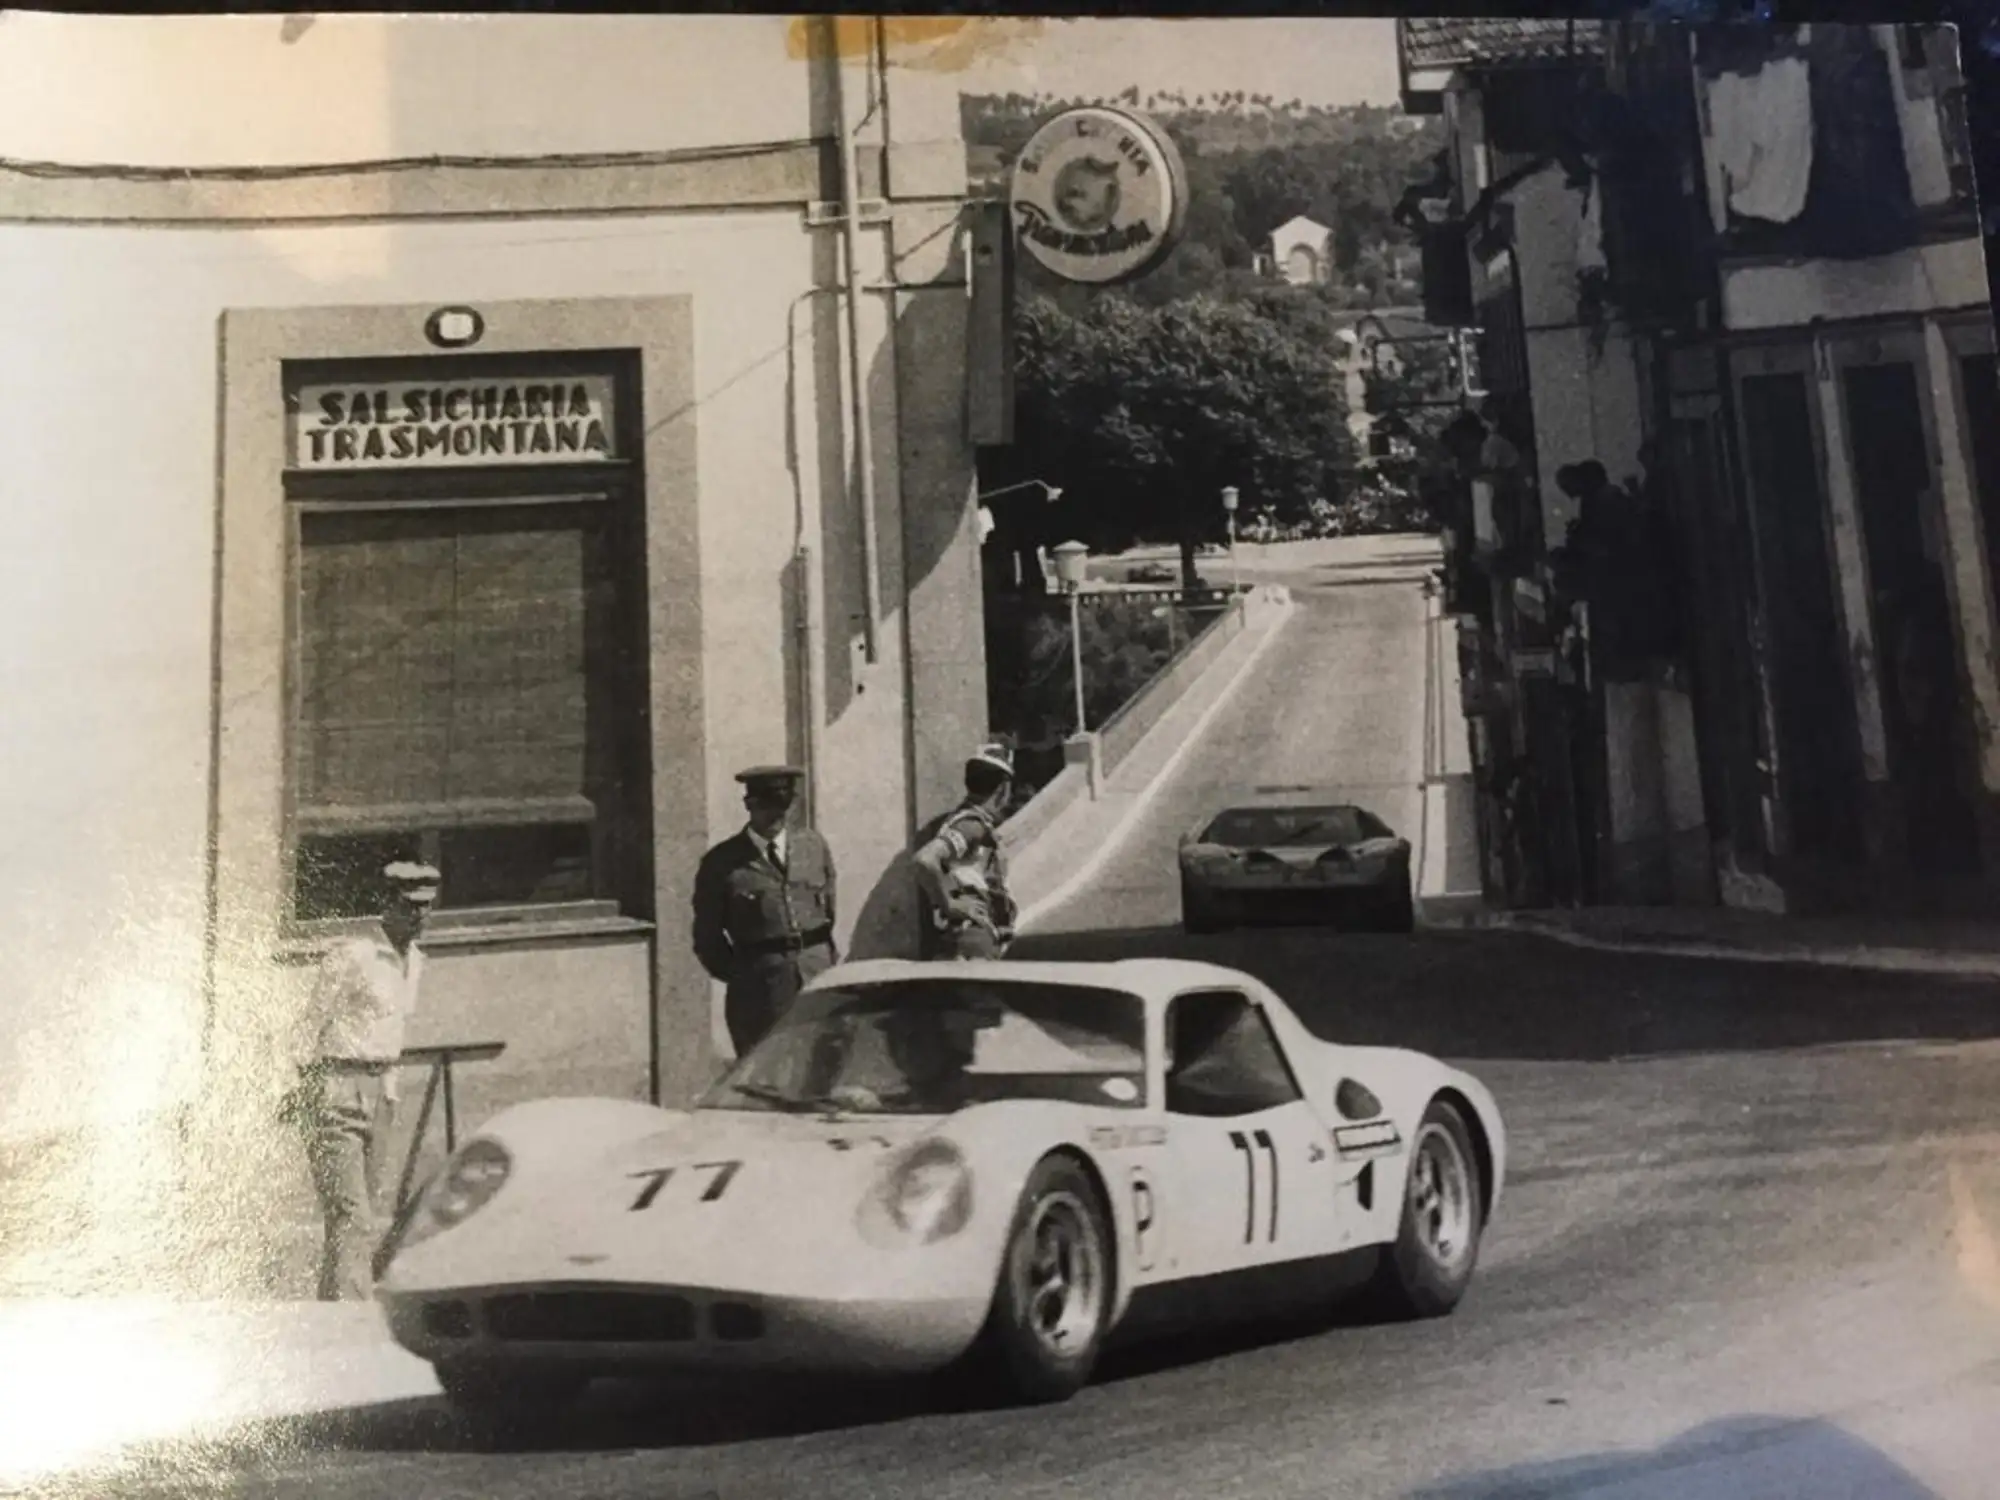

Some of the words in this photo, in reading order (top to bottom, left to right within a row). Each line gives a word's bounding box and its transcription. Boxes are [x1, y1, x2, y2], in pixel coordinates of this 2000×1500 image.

[318, 383, 592, 426] SALSICHARIA
[305, 420, 610, 462] TRASMONTANA
[626, 1160, 744, 1211] 77
